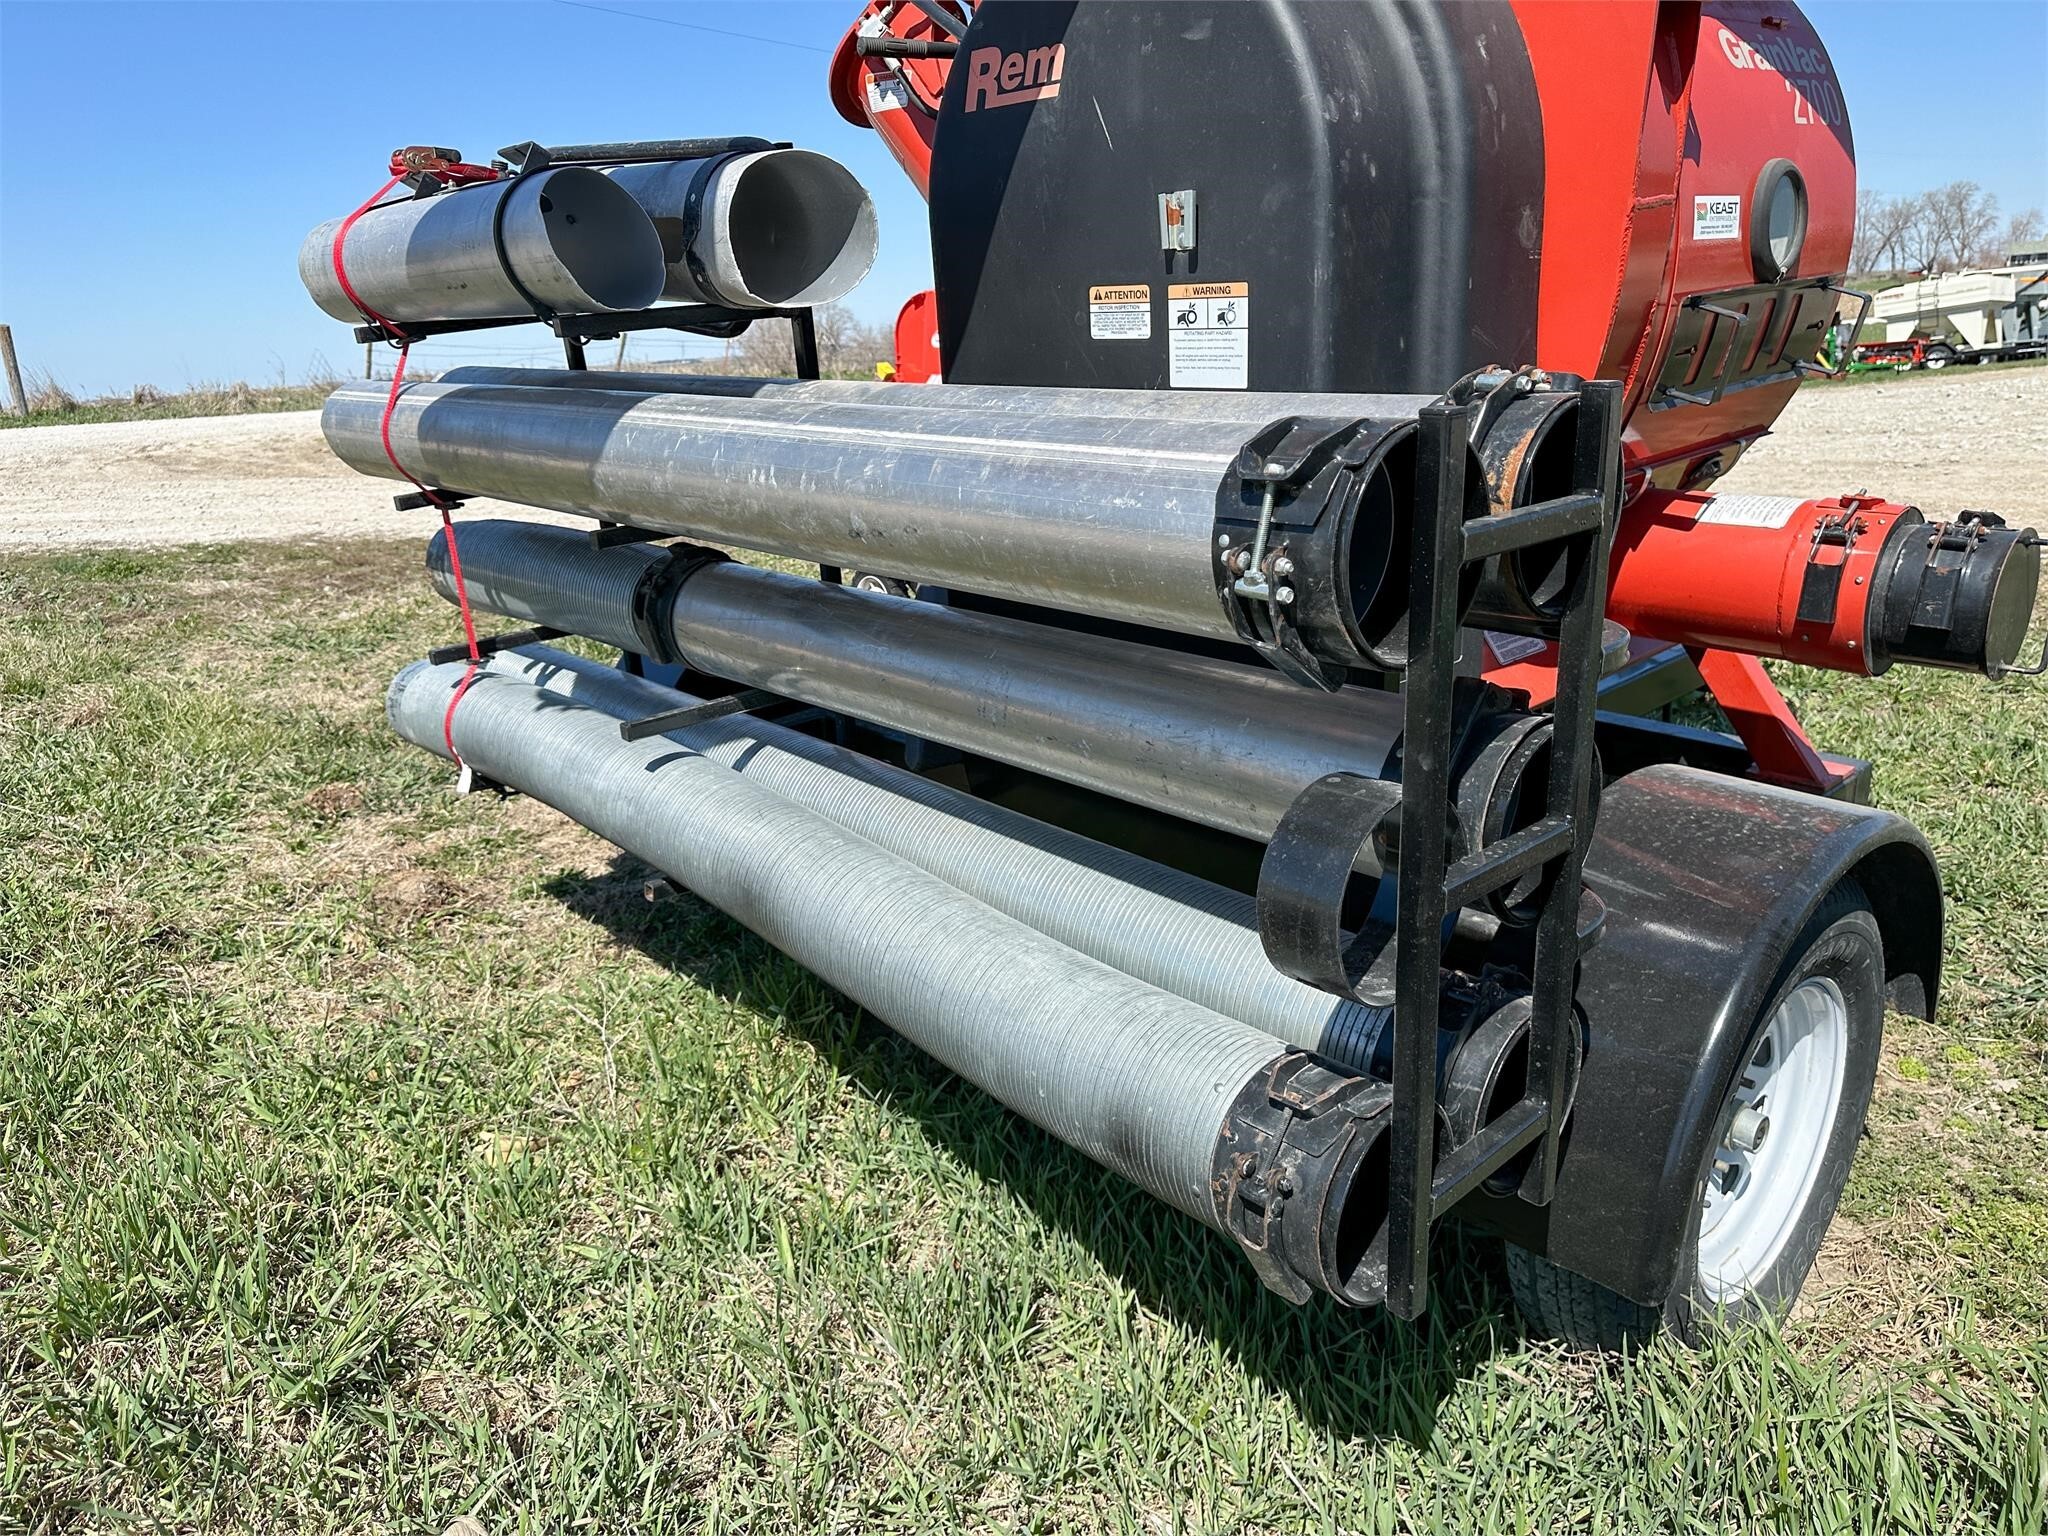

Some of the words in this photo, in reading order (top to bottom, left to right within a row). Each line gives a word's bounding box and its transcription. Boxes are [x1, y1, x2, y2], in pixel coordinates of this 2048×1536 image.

[1718, 28, 1826, 75] GrainVac
[965, 43, 1066, 113] Rem
[1785, 78, 1841, 126] 2700
[1709, 202, 1739, 215] KEAST
[1103, 289, 1148, 300] ATTENTION
[1192, 285, 1232, 296] WARNING
